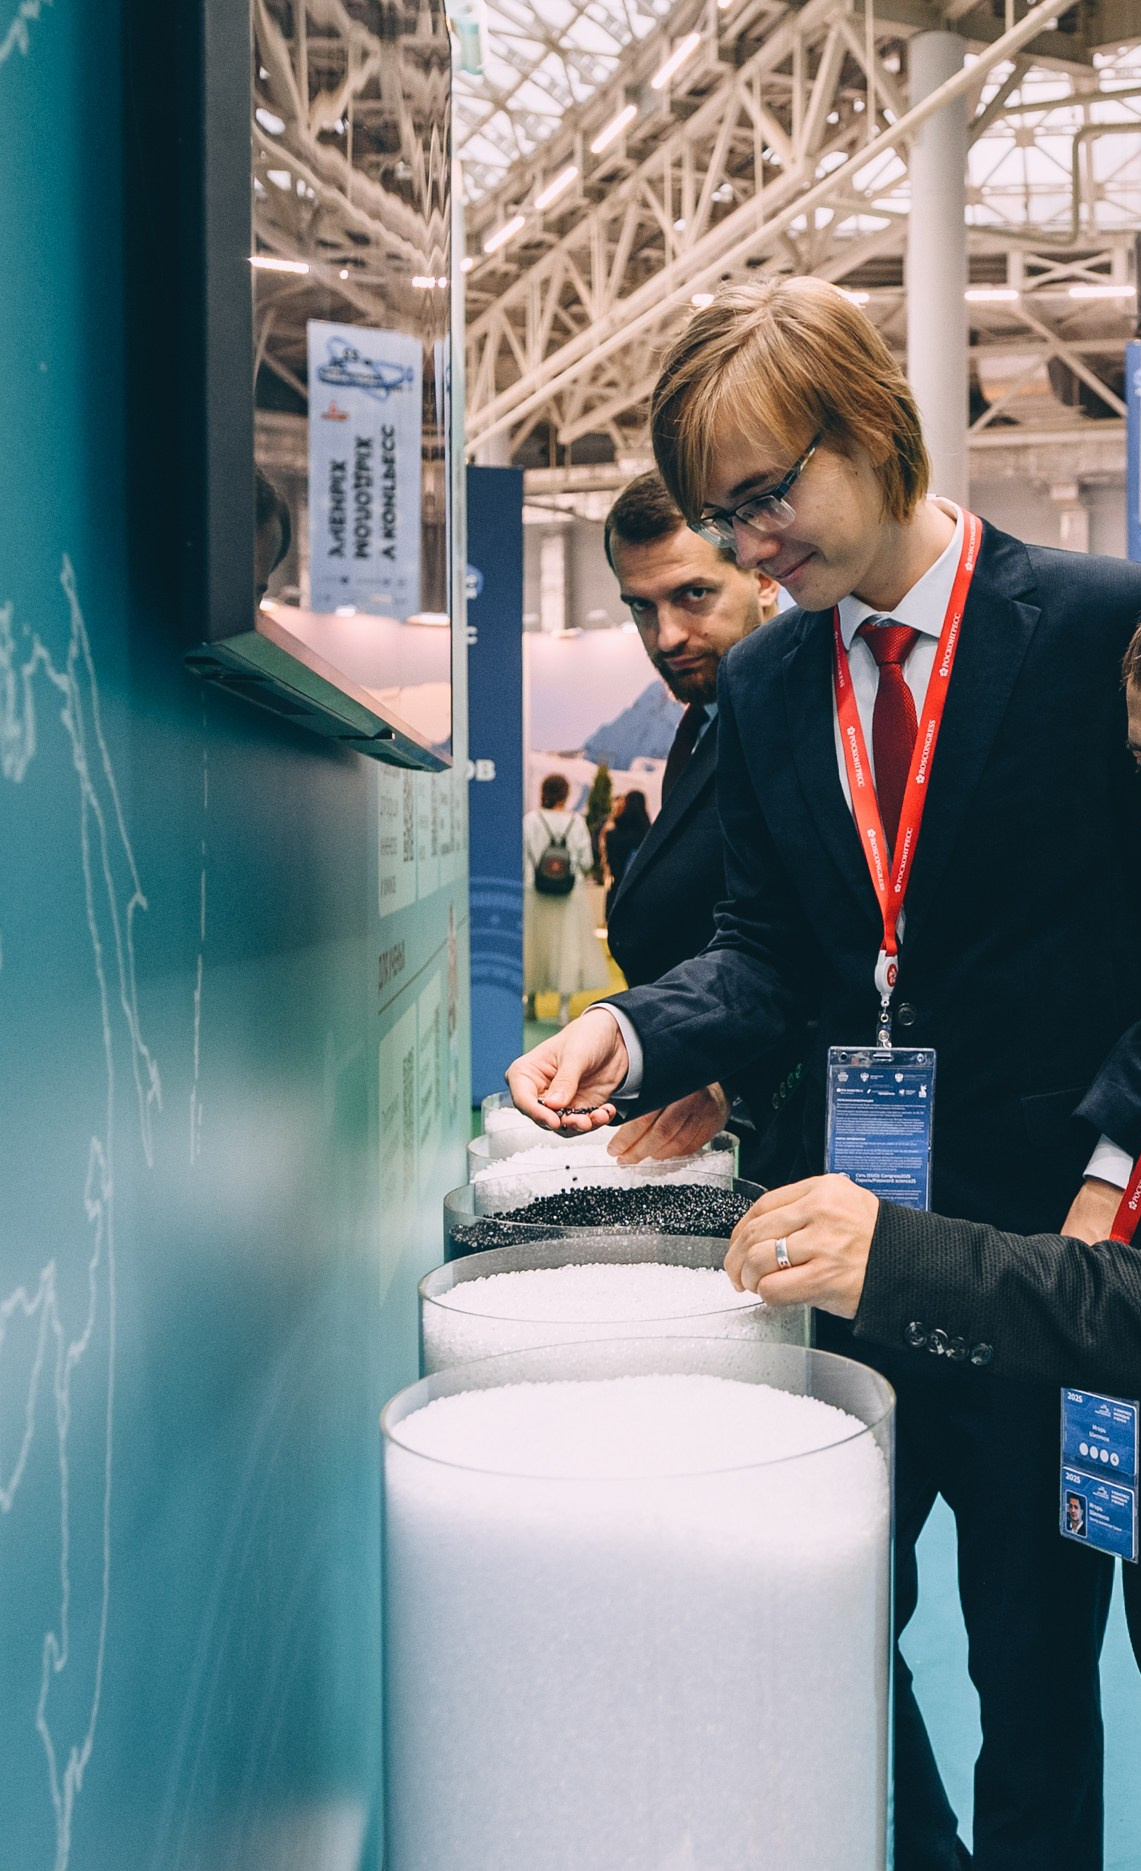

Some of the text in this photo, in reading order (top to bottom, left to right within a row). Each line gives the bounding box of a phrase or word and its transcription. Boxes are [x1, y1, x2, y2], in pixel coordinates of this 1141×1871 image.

[943, 612, 962, 669] РОСКОНГРЕСС
[849, 734, 866, 788] РОСКОНГРЕСС
[919, 718, 937, 776] ROSCONGRESS
[870, 838, 885, 892] ROSCONGRESS
[896, 826, 914, 885] РОСКОНГРЕСС
[1067, 1391, 1083, 1404] 2025
[1065, 1472, 1081, 1485] 2025
